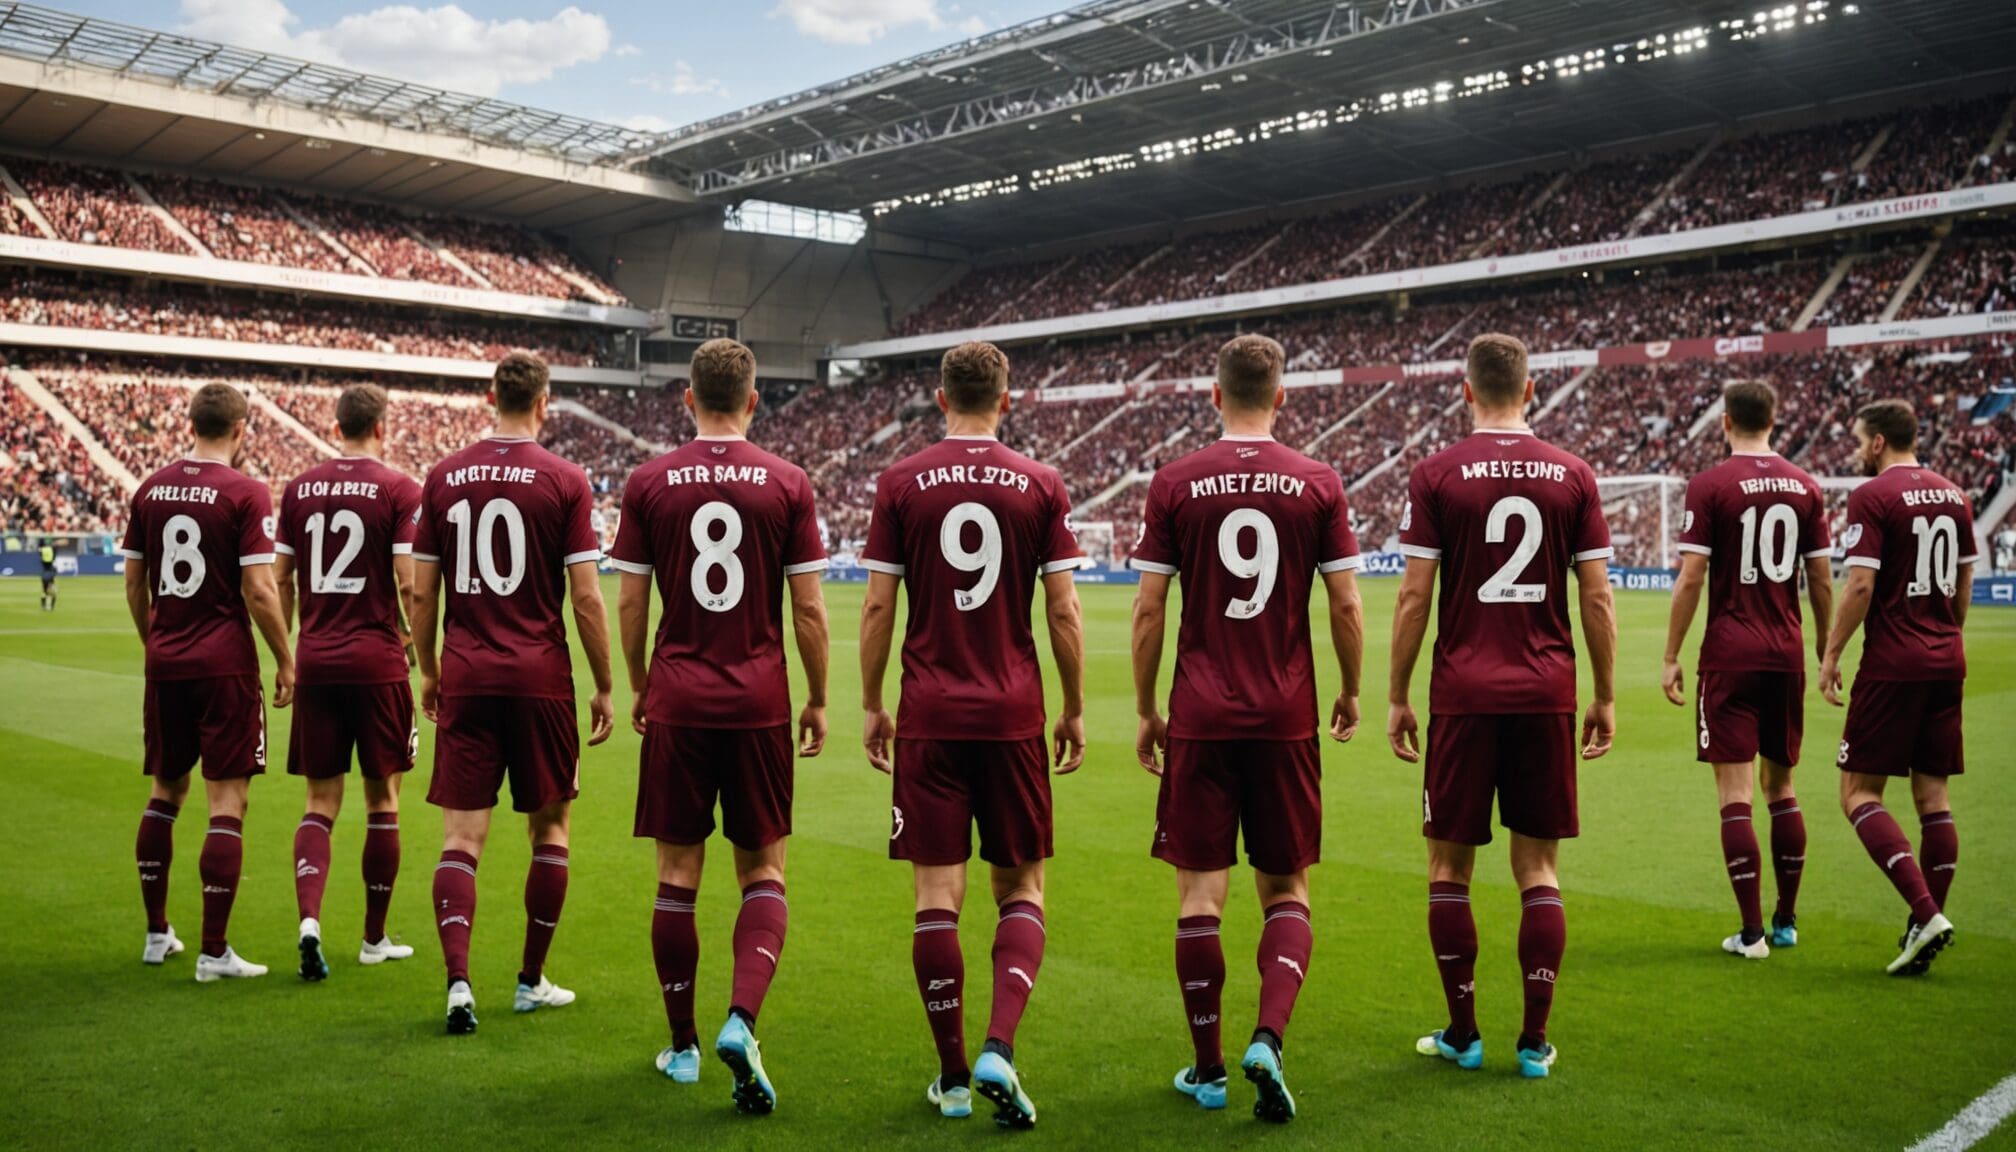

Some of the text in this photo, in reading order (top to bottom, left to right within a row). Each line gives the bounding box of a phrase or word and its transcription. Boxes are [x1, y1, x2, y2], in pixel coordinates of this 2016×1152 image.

[159, 514, 206, 598] 8
[305, 509, 366, 594] 12
[446, 498, 526, 597] 10
[691, 501, 745, 613] 8
[940, 501, 1003, 611] 9
[1218, 508, 1279, 619] 9
[1477, 496, 1547, 603] 2
[1740, 503, 1799, 584] 10
[1907, 515, 1959, 598] 10
